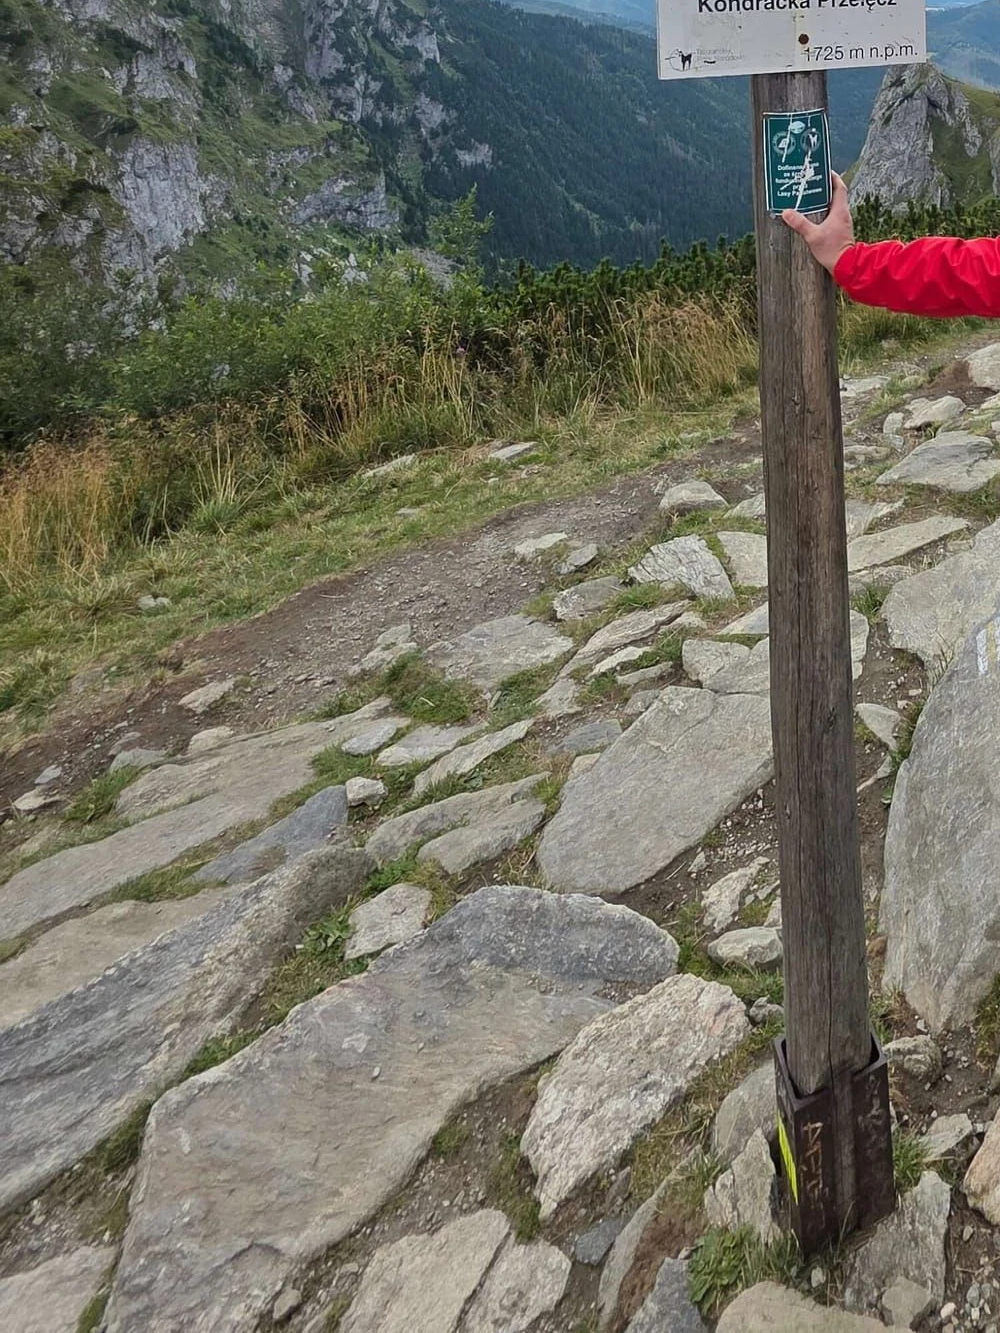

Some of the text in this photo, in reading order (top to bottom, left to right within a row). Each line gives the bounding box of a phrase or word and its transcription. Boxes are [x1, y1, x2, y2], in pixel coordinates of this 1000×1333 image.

[804, 44, 918, 62] 1725 m n.p.m.
